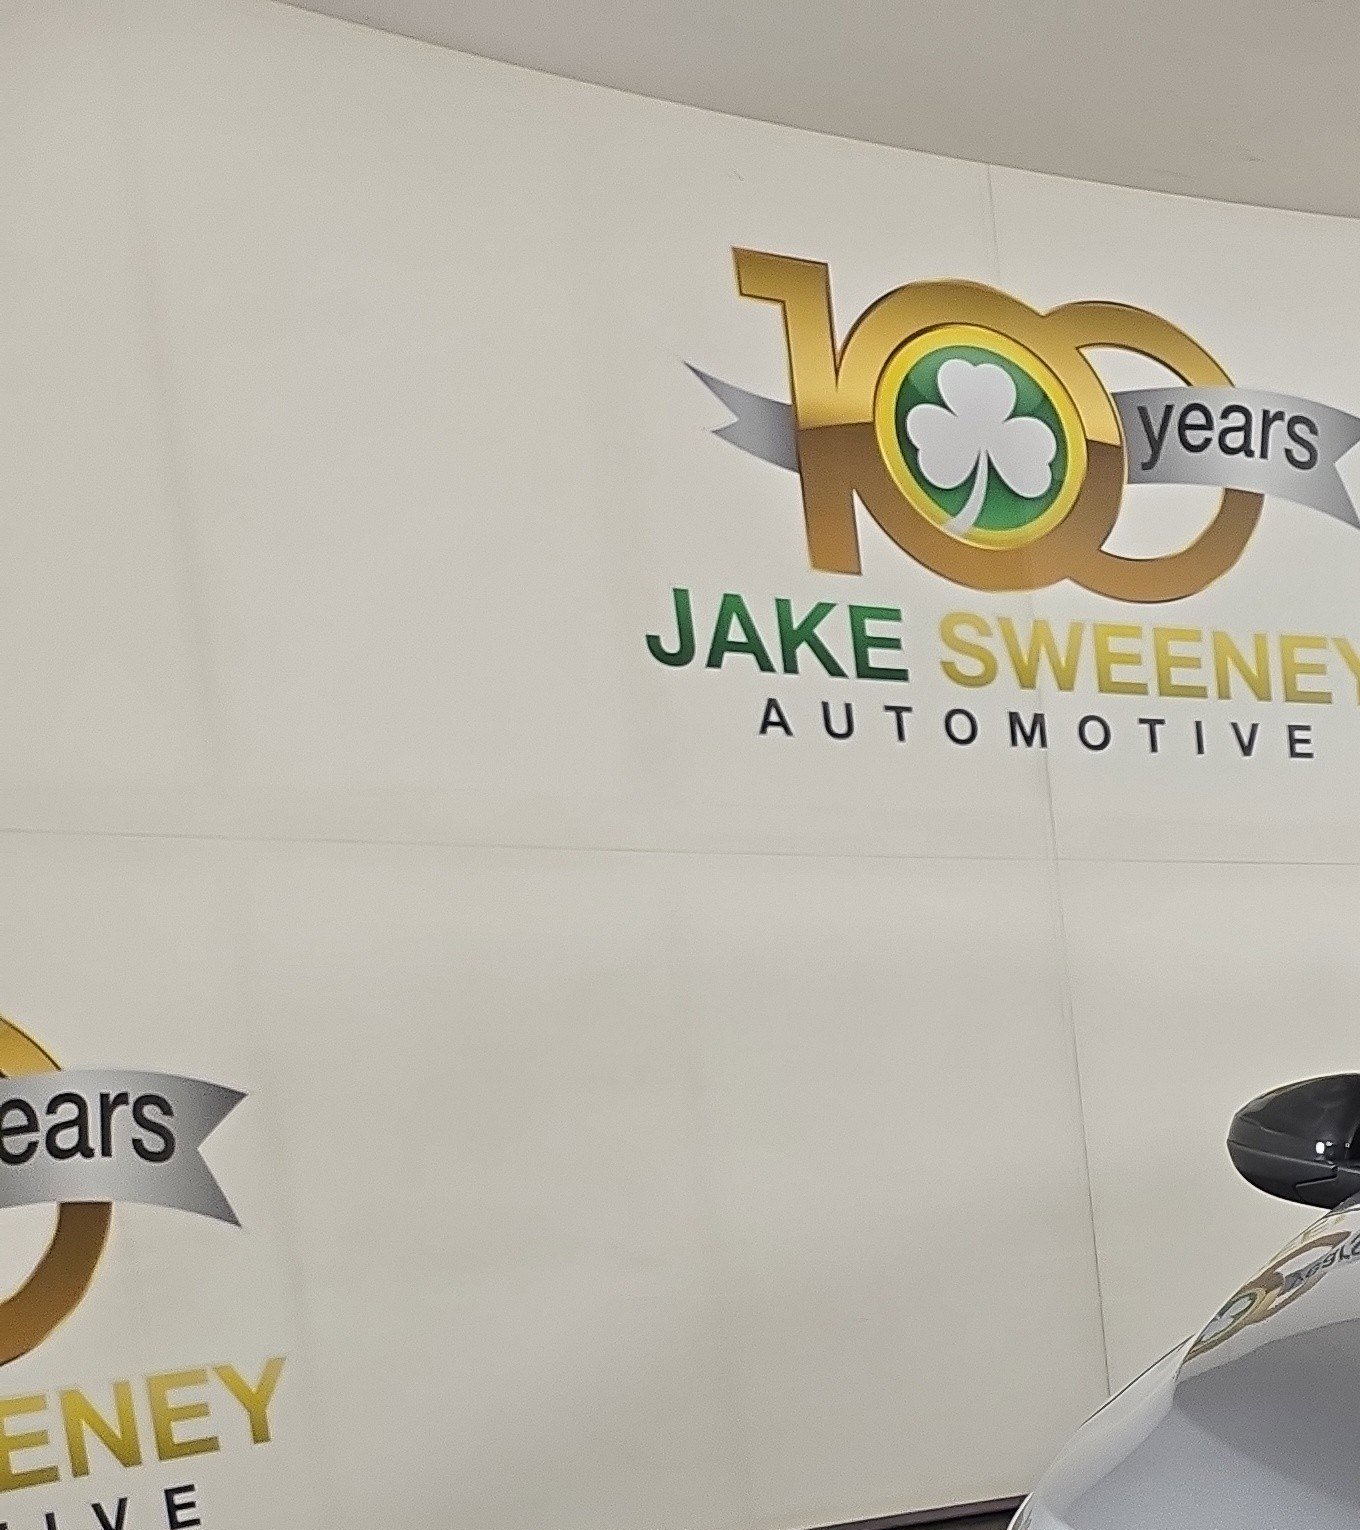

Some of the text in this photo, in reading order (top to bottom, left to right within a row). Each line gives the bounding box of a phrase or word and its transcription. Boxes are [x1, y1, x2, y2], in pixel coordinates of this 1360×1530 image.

[731, 246, 1320, 603] 100 years
[645, 588, 910, 682] JAKE
[758, 698, 1316, 759] AUTOMOTIVE
